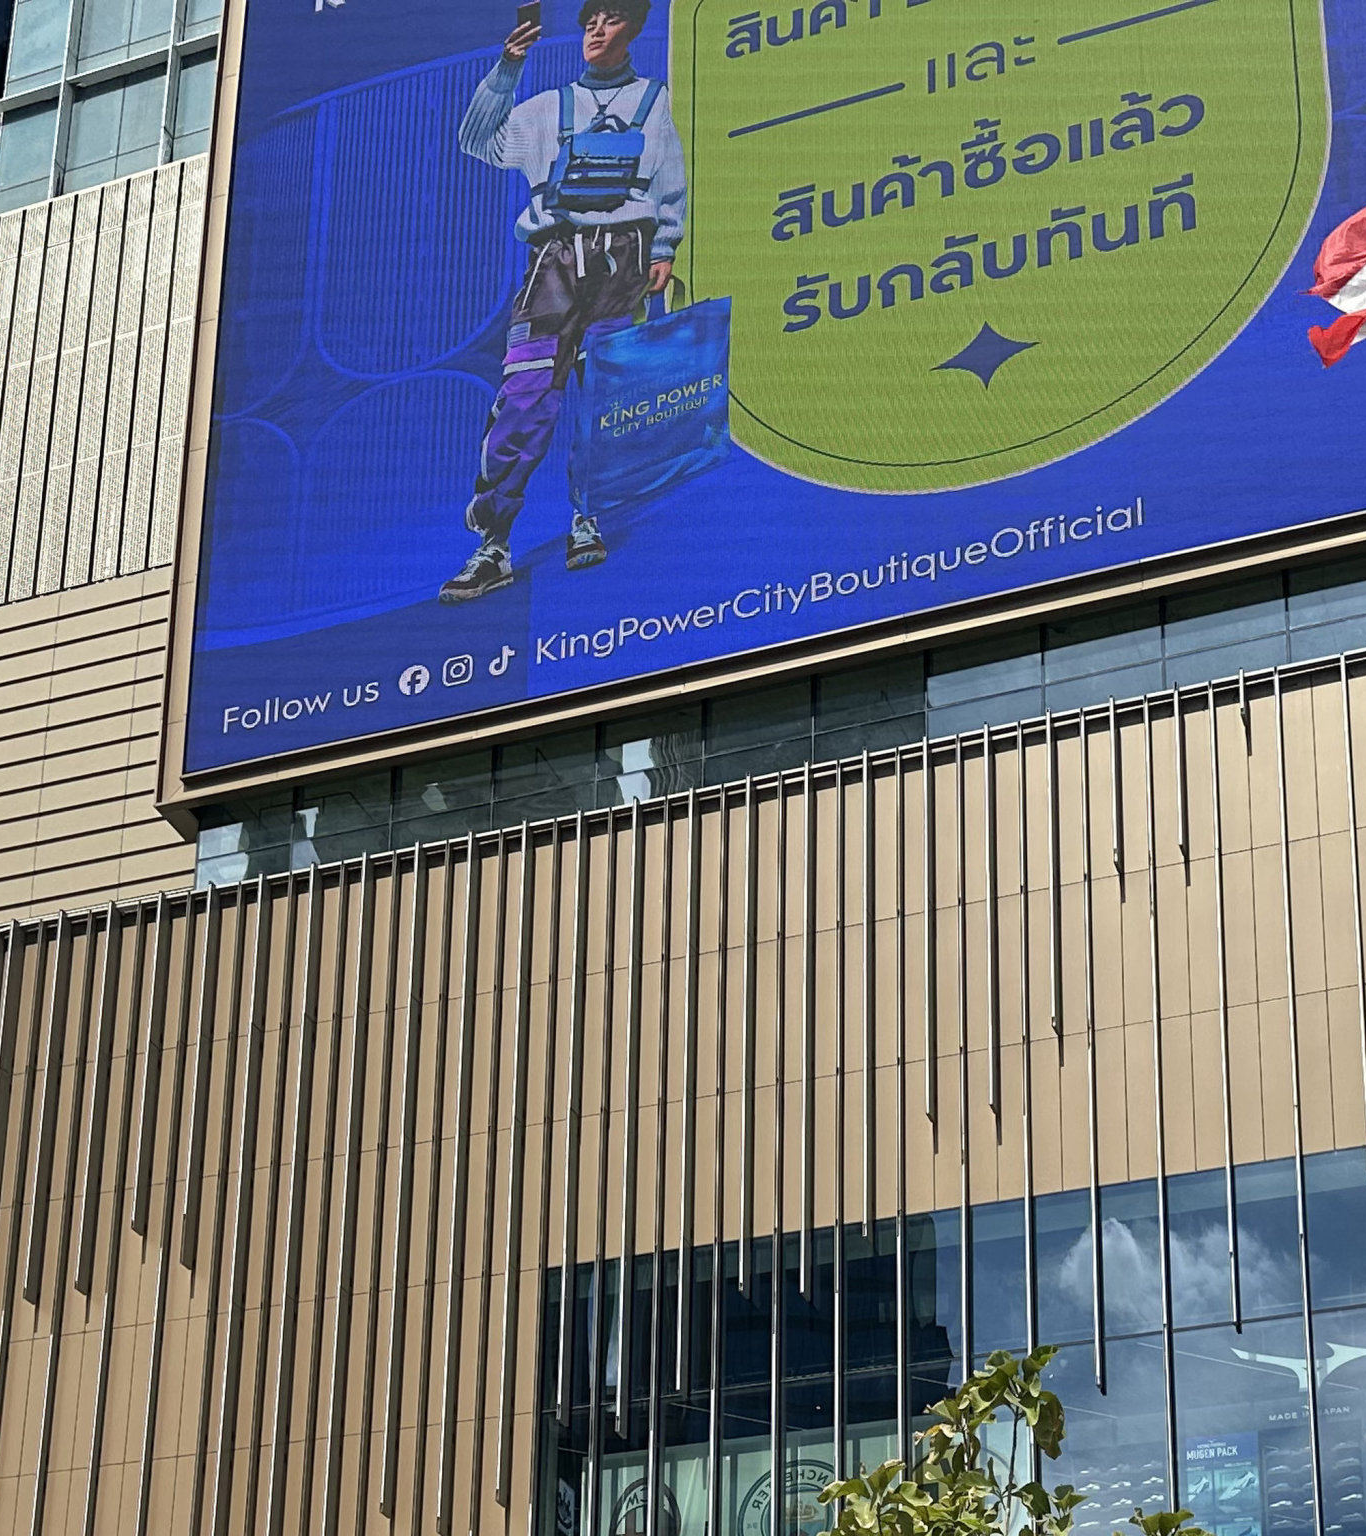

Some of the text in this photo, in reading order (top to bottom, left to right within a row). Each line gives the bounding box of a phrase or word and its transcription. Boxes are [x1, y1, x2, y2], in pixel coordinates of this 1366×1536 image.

[927, 35, 1036, 94] และ
[771, 91, 1206, 242] สินค้าซื้อแล้ว
[782, 172, 1198, 333] รับกลับทันที
[600, 374, 724, 430] KING POWER
[613, 420, 642, 438] CITY
[536, 496, 1144, 665] KingPowerCityBoutiqueOfficial
[222, 682, 380, 734] Follow us
[1319, 1406, 1351, 1416] APAN
[1187, 1446, 1239, 1461] MUGEN PACK
